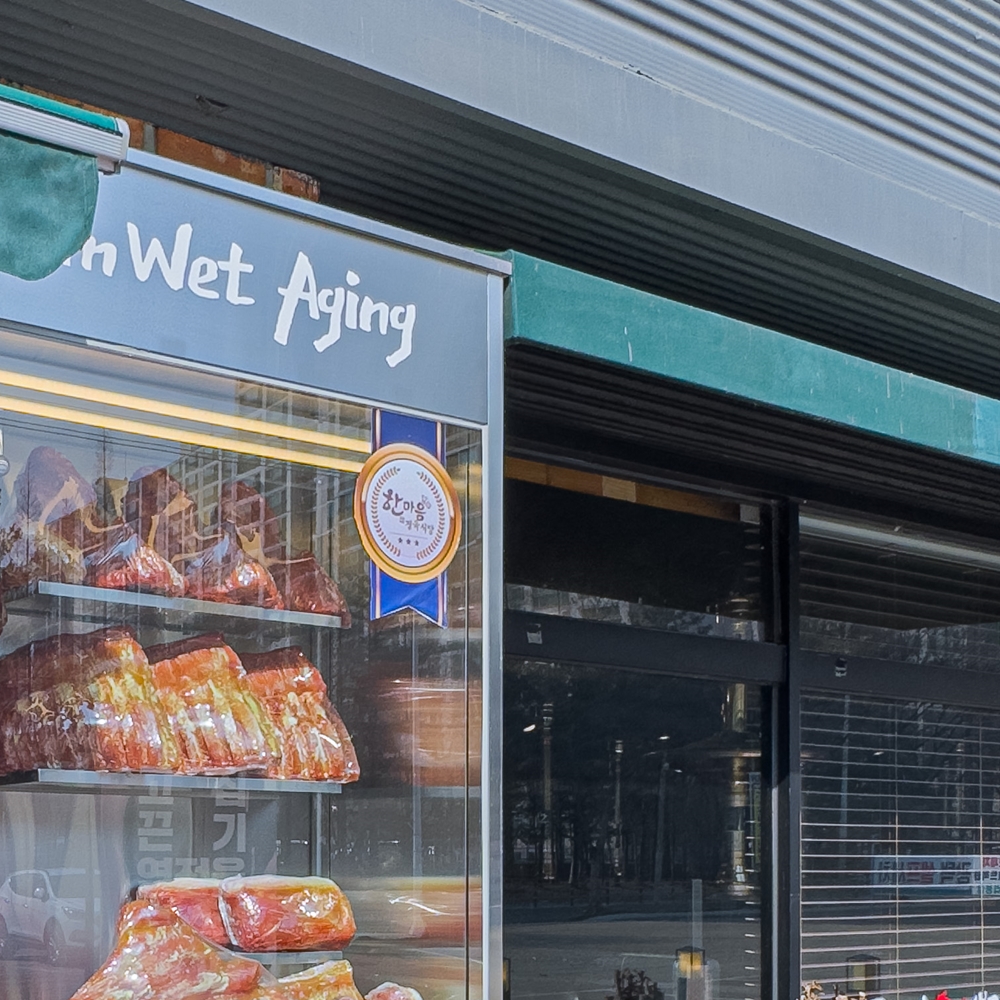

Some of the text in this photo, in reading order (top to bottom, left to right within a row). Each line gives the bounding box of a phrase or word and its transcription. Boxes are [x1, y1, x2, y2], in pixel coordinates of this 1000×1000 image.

[127, 222, 255, 305] Wet
[273, 251, 416, 367] Aging
[383, 489, 427, 521] 한마음
